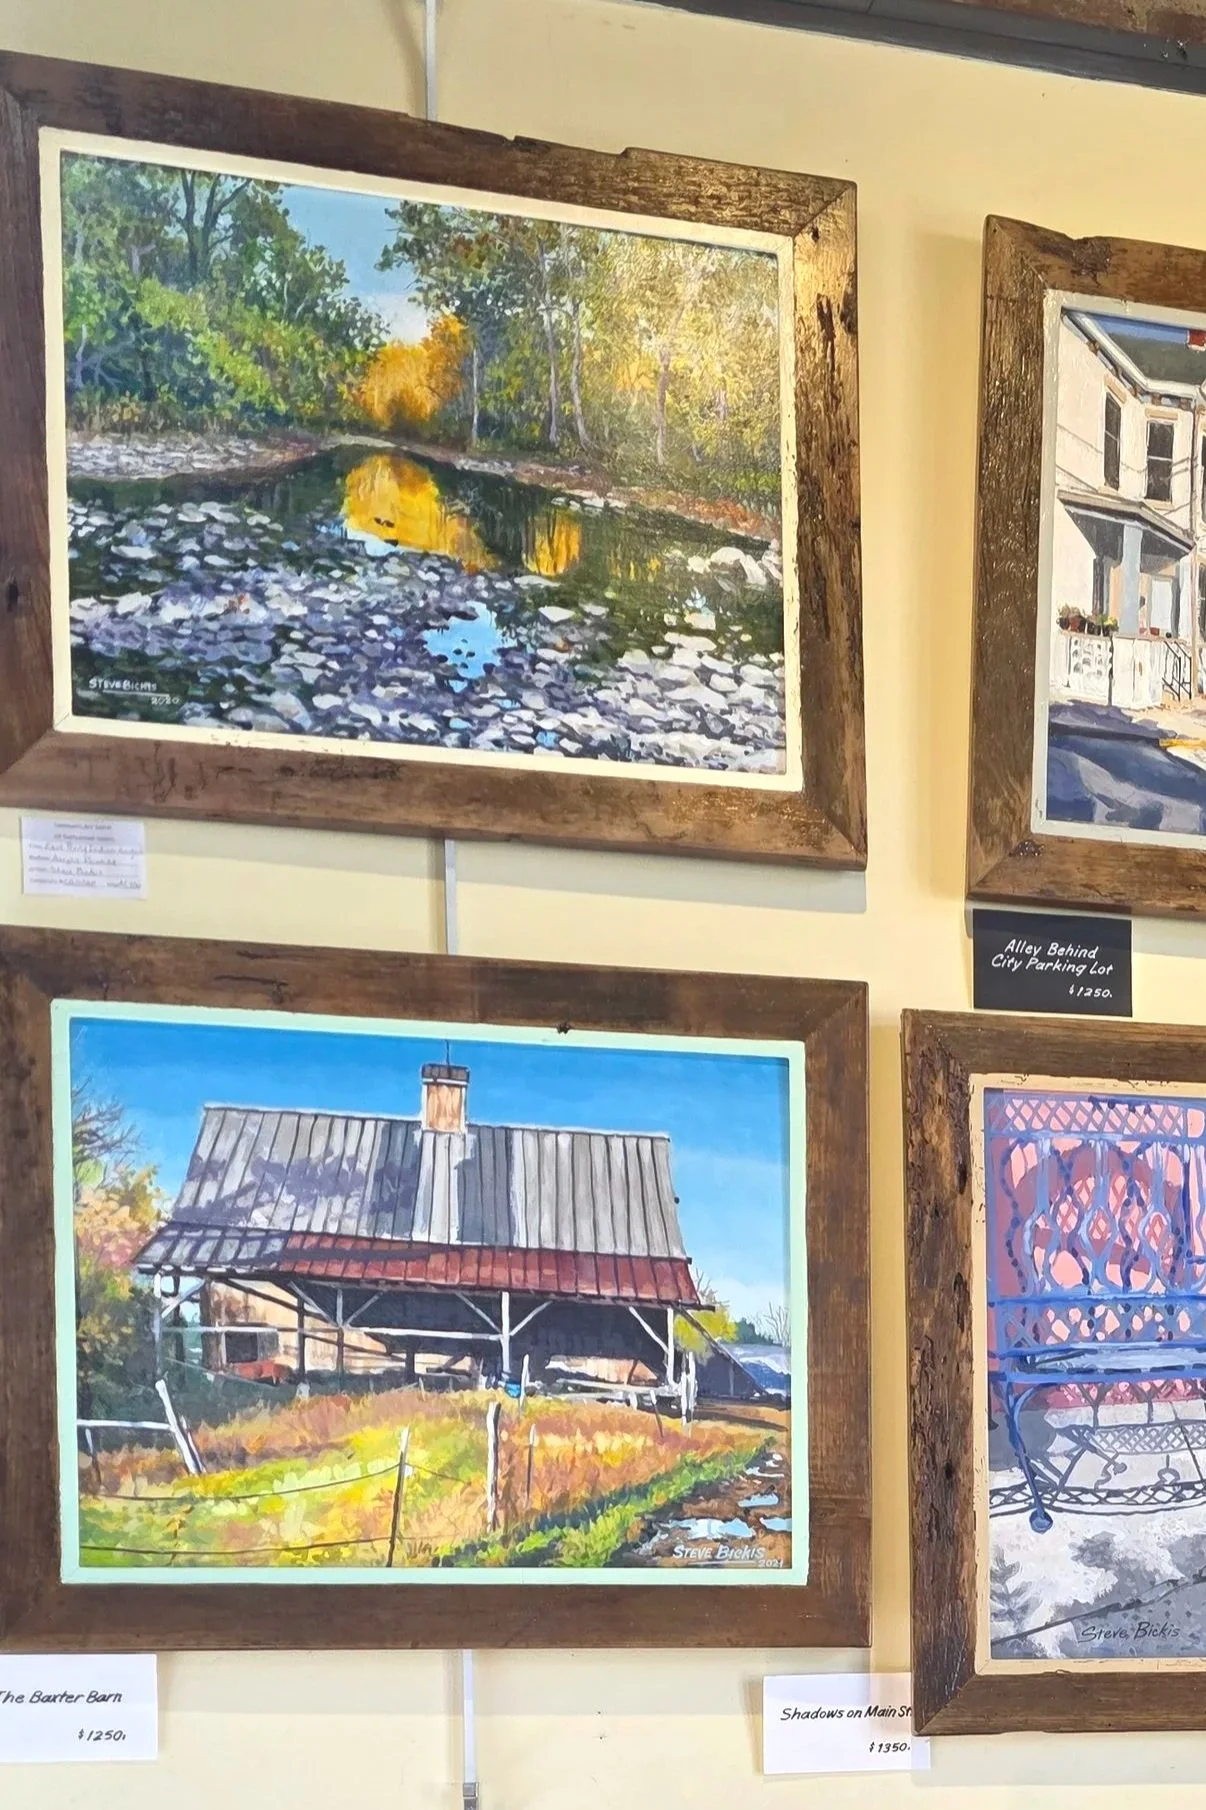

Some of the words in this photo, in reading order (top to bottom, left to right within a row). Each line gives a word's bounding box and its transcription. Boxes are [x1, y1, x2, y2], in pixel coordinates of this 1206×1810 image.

[1004, 939, 1042, 957] Alley
[1046, 942, 1099, 960] Behind
[991, 953, 1023, 972] City
[1025, 957, 1087, 977] Parking
[1089, 961, 1114, 976] Lot
[672, 1544, 713, 1559] STEVE
[1133, 1621, 1181, 1640] Bickis
[28, 1690, 85, 1704] Baxter
[86, 1690, 123, 1704] Barn
[780, 1706, 844, 1721] Shadows
[846, 1708, 863, 1719] on
[864, 1704, 897, 1718] Main
